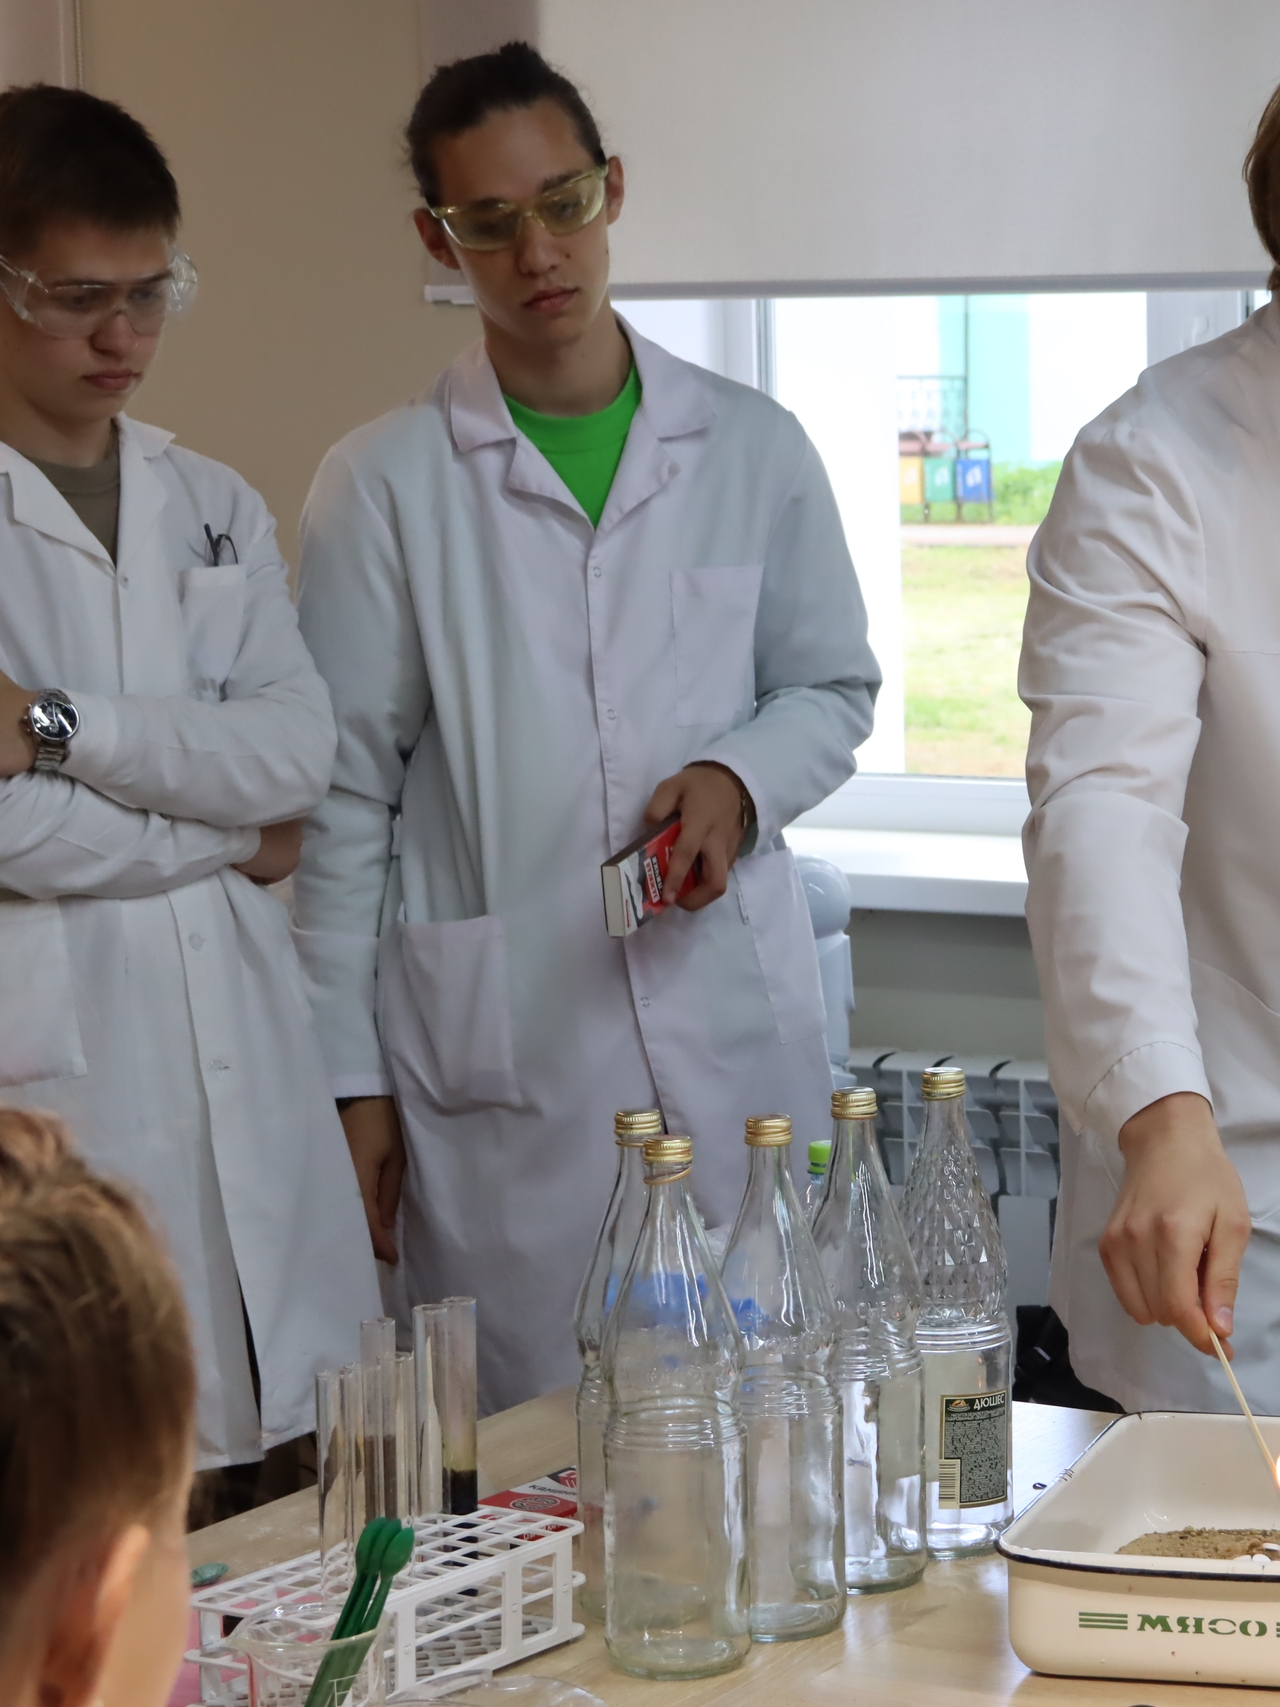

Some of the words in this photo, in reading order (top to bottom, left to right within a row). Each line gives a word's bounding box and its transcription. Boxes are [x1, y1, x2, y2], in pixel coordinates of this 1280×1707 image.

[651, 856, 663, 893] ПИЧКИ
[973, 1393, 1005, 1410] ДЮШЕС
[1137, 1613, 1268, 1637] МЯСО
